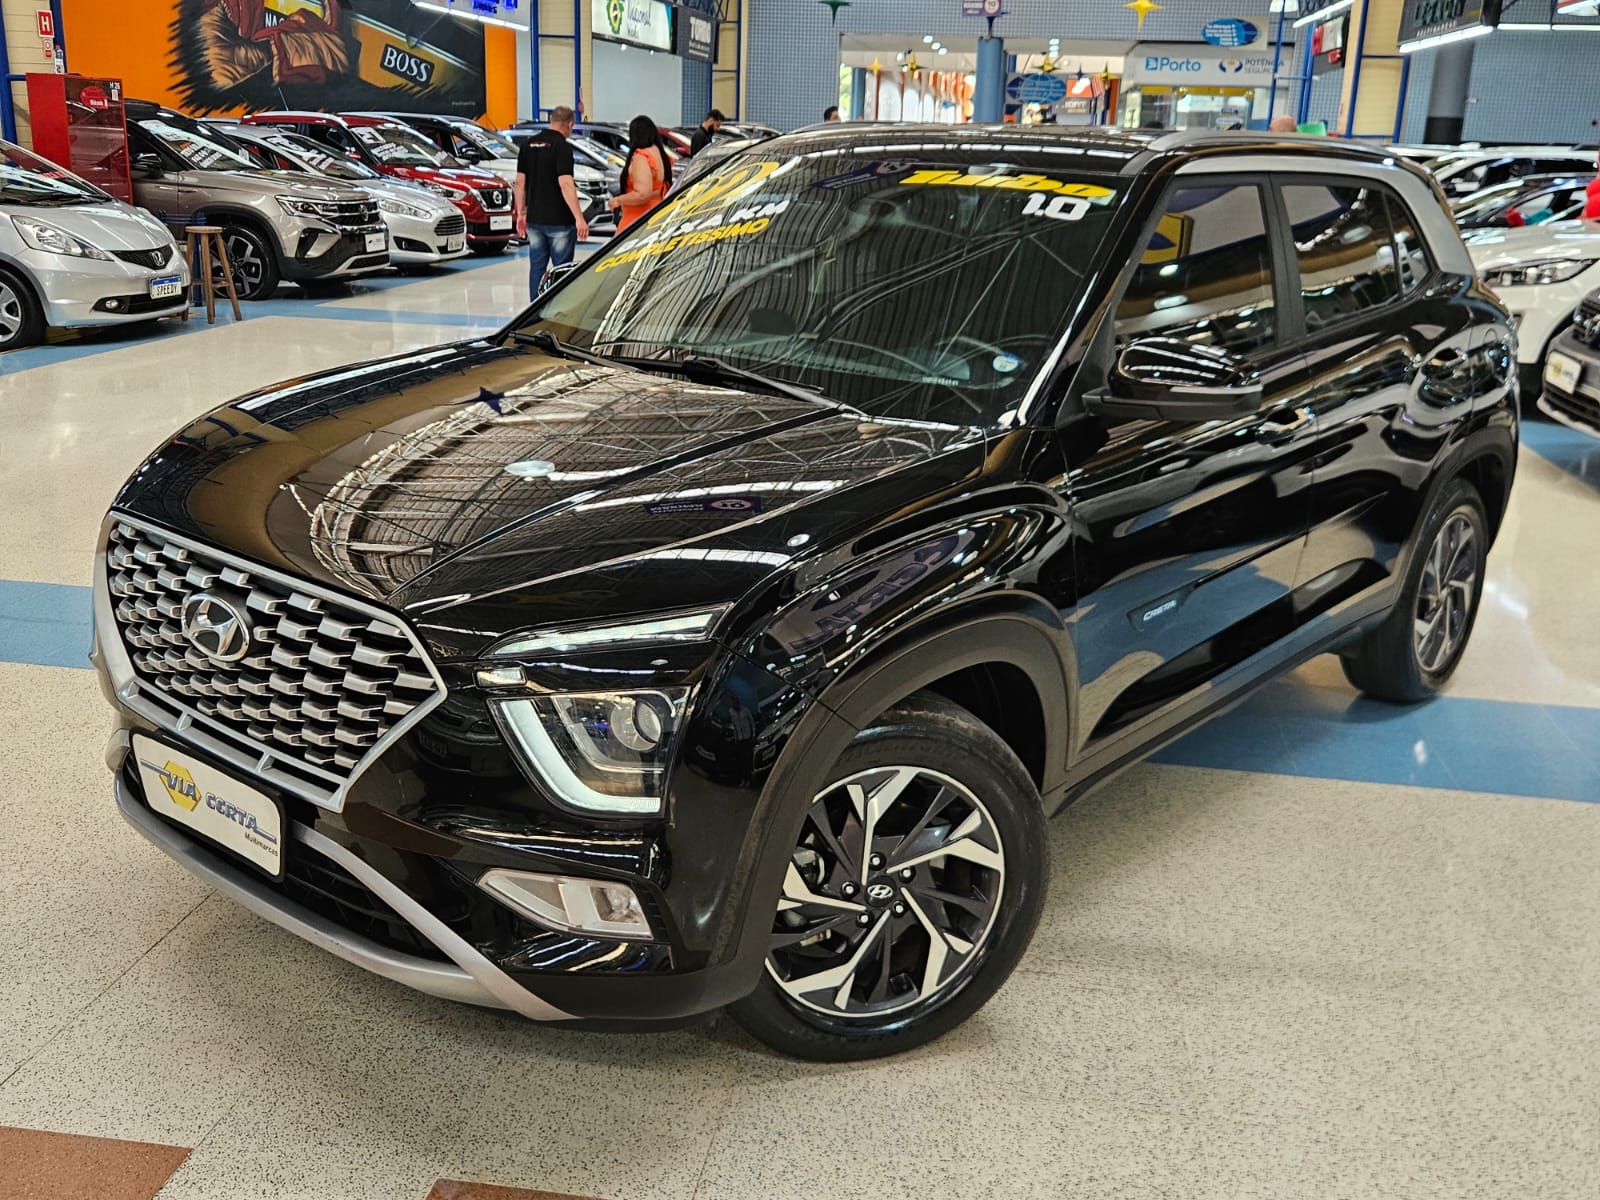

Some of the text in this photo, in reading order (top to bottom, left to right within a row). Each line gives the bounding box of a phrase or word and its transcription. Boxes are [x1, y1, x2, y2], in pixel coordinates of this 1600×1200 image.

[41, 15, 50, 32] H
[383, 46, 430, 82] BOSS
[1159, 56, 1201, 72] Porto
[899, 170, 1113, 198] Turbo
[729, 199, 790, 223] KM
[1021, 192, 1092, 221] 1.0
[166, 774, 258, 833] VIA CERTA
[244, 831, 279, 857] Multimarcas
